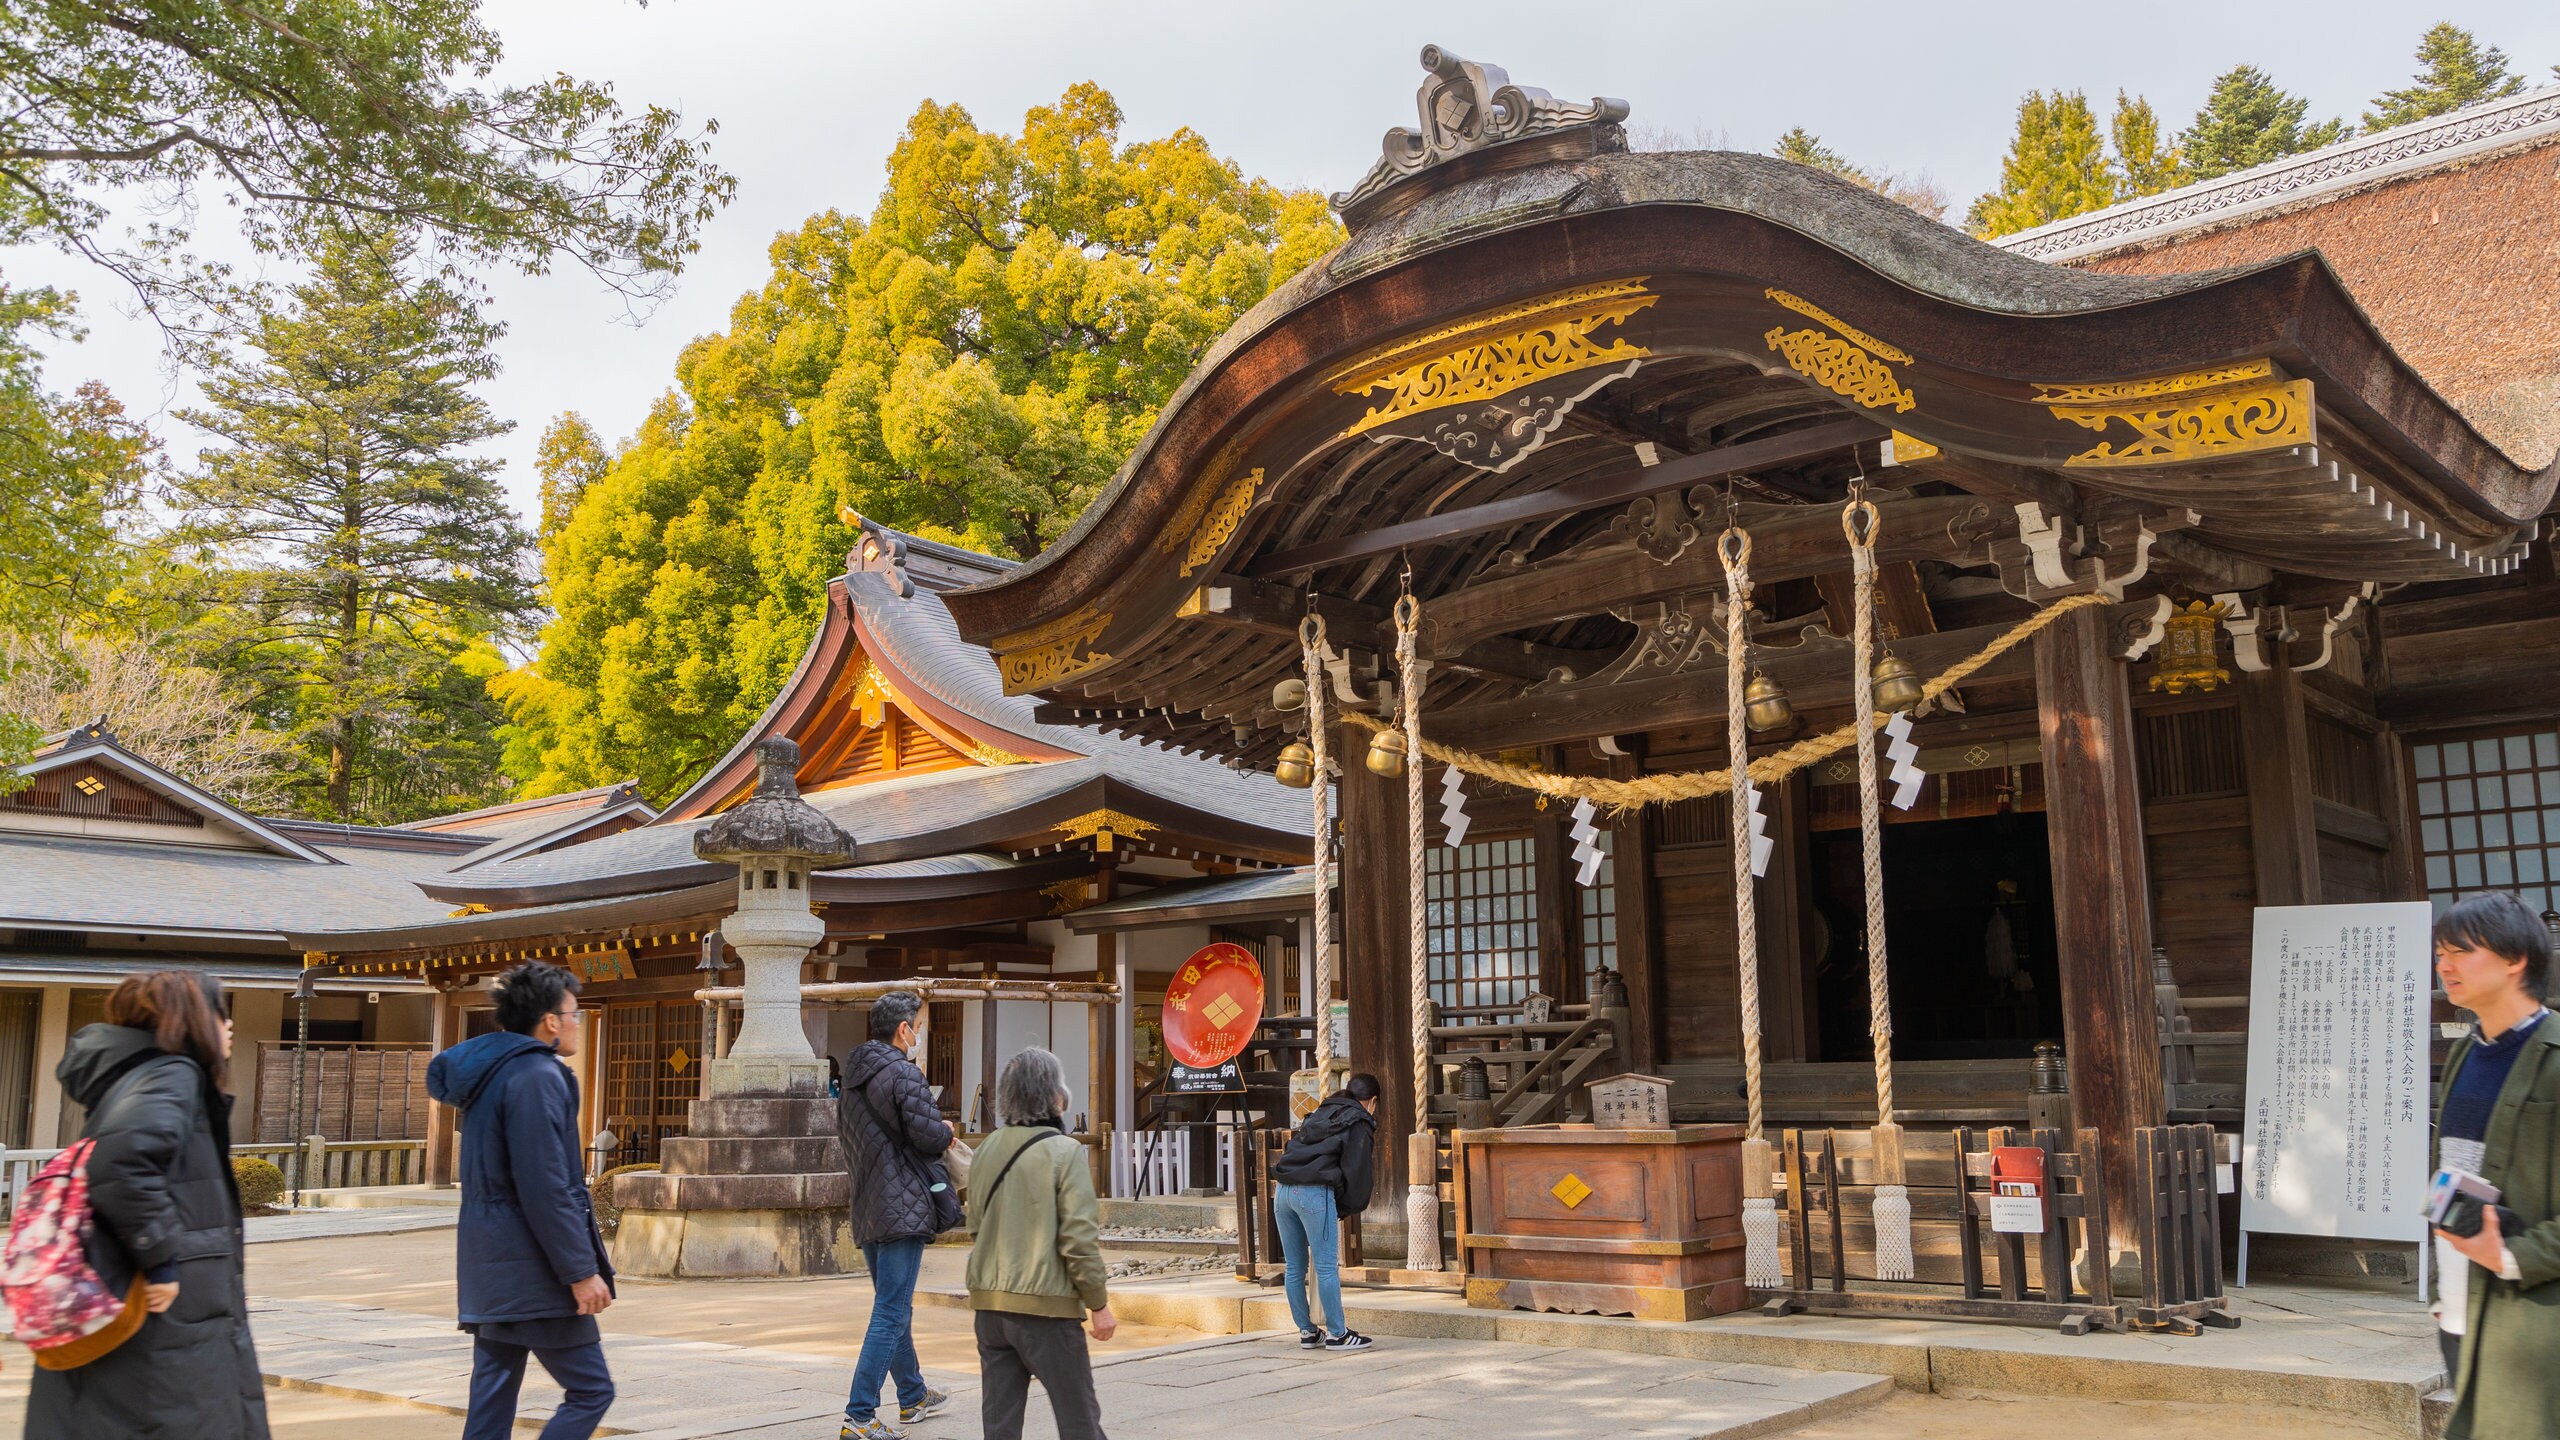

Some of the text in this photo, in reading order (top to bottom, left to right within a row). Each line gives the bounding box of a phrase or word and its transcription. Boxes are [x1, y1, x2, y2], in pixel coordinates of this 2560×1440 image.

[2313, 945, 2323, 992] 一、特別会員
[2325, 945, 2335, 984] 一、正会員
[2338, 927, 2349, 1012] 会員は左のとおりです。
[2374, 926, 2384, 1012] となり創建されました。
[1171, 1064, 1236, 1080] 奉 納
[2401, 970, 2415, 1123] 武田神社崇敬会入会のご案内
[1616, 1089, 1626, 1122] 二拍手
[2254, 1097, 2269, 1201] 武田神社崇敬会事務局
